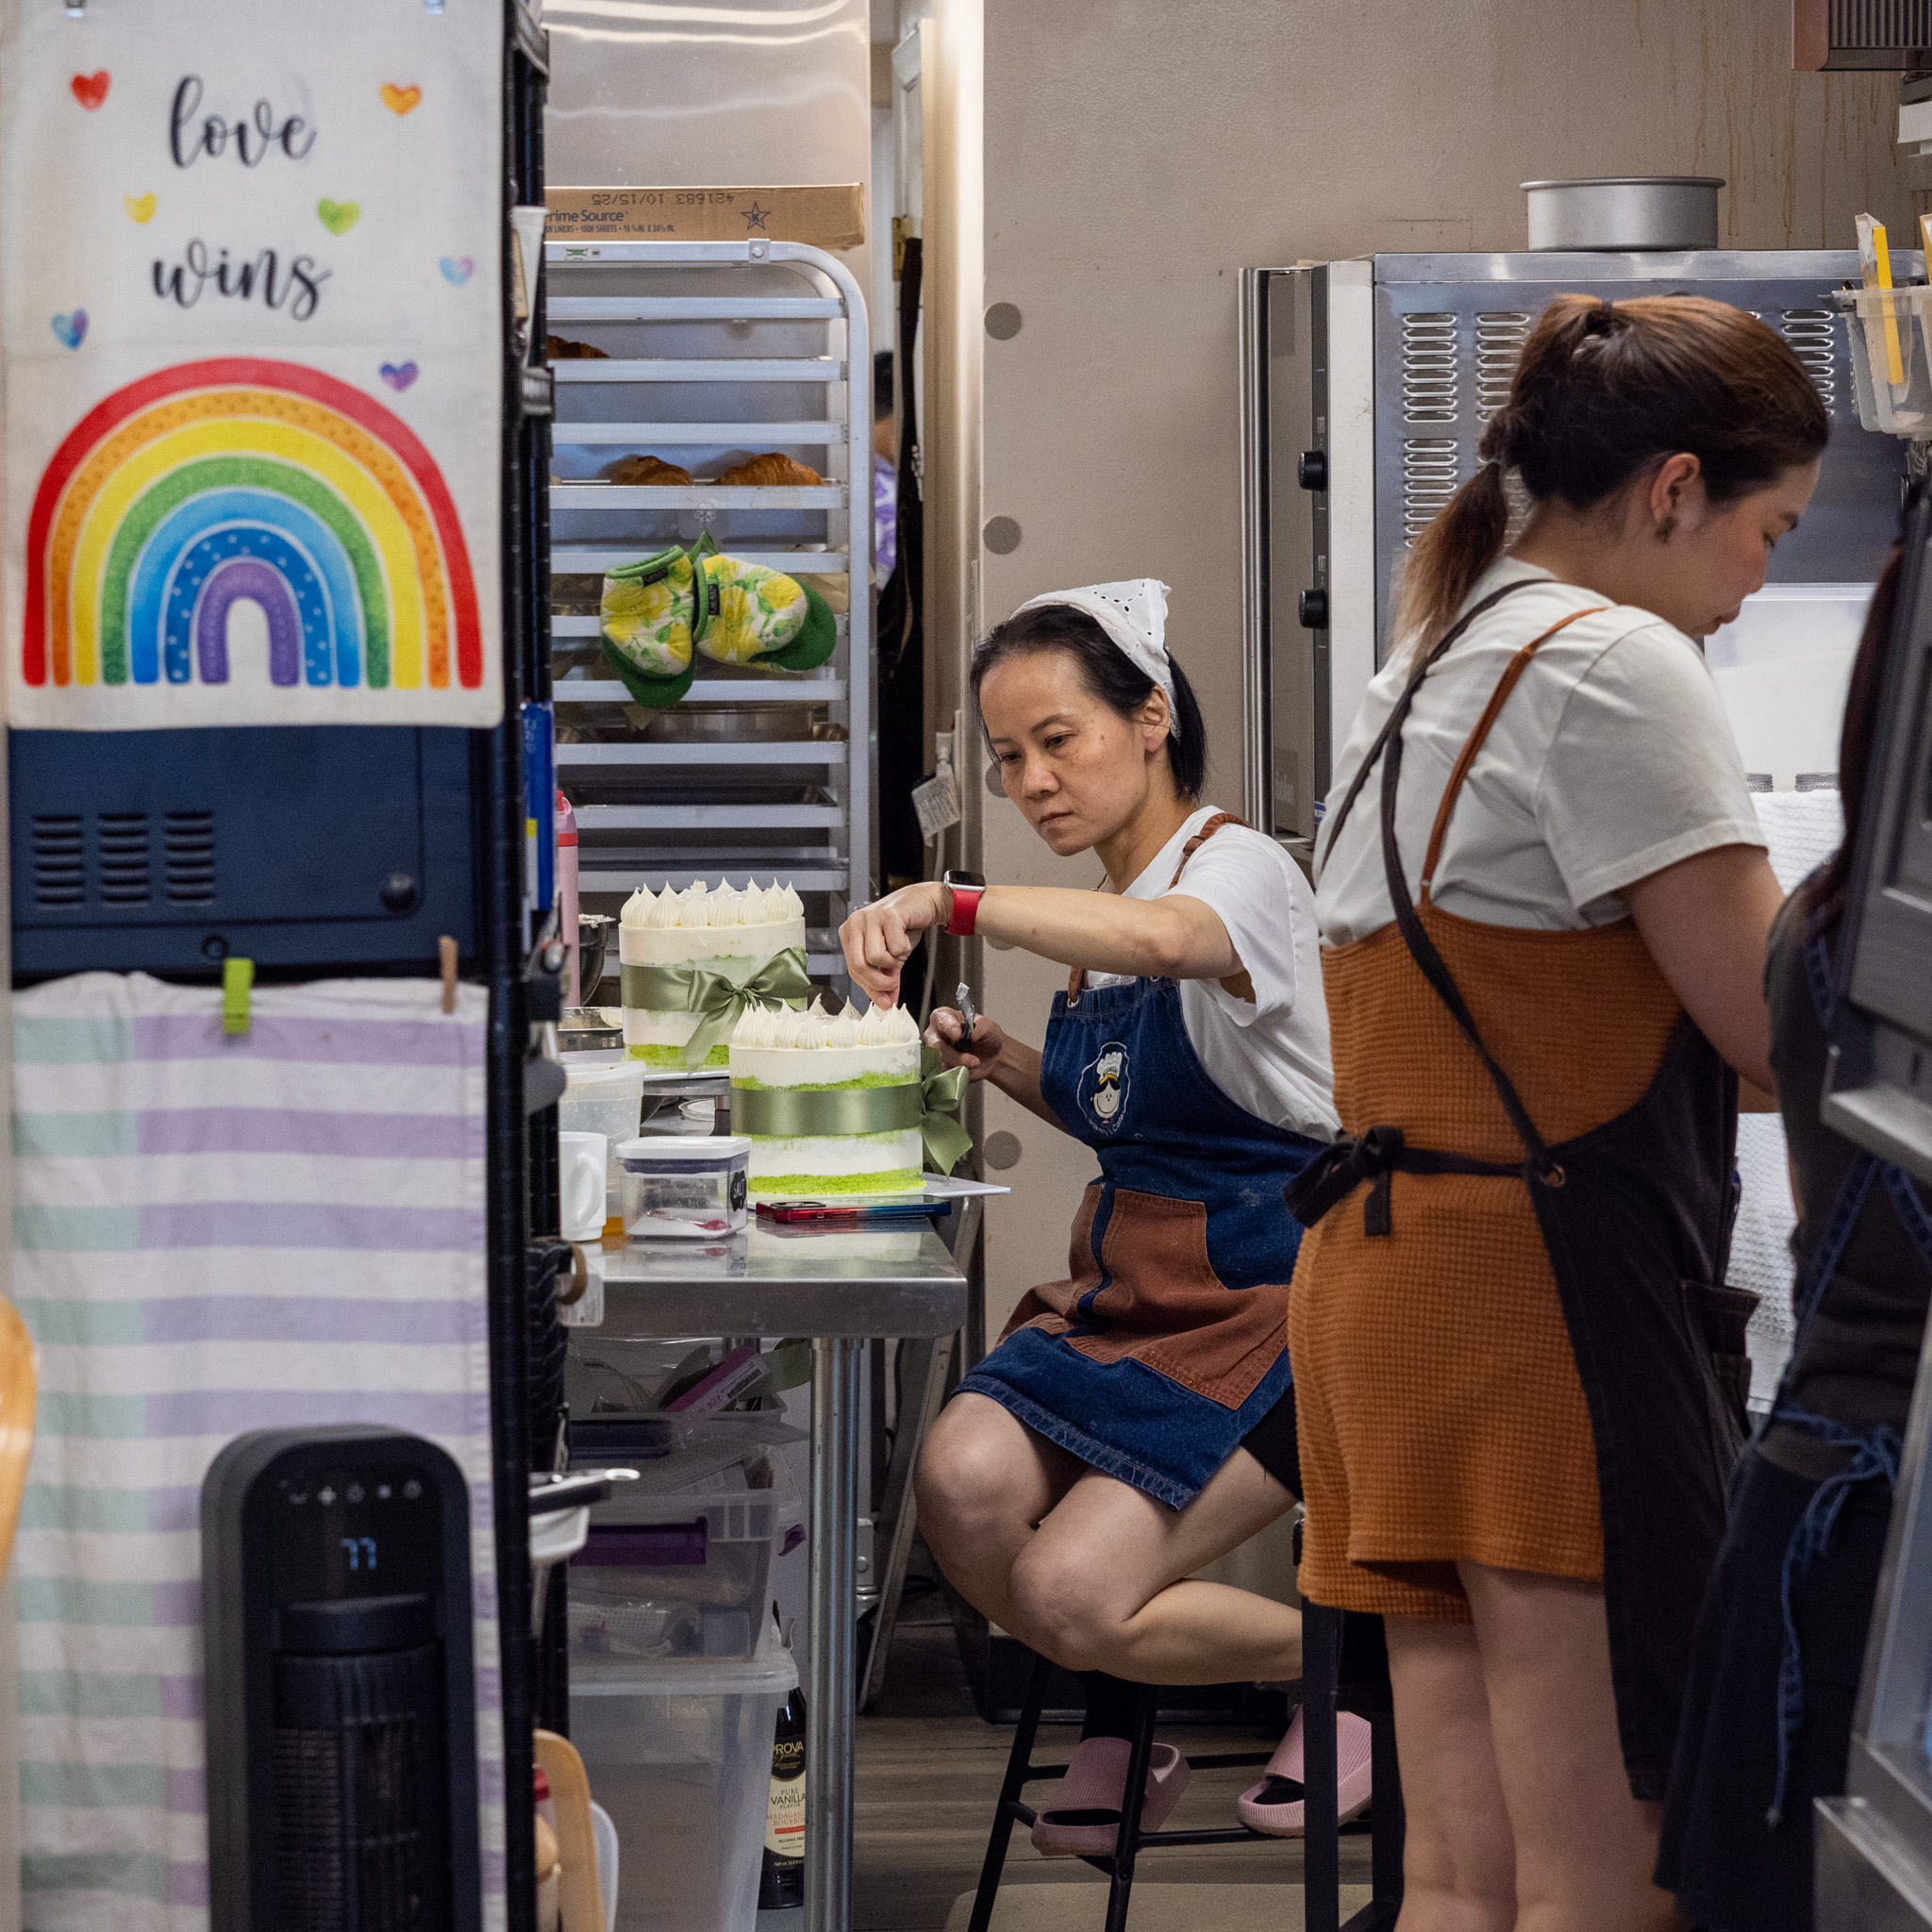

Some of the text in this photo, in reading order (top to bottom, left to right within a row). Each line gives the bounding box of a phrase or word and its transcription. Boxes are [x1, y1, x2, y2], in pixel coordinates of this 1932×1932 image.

[168, 74, 317, 170] love
[591, 192, 735, 206] 421683 10/15/25
[544, 209, 625, 223] rime Source
[543, 225, 553, 233] AN
[595, 225, 617, 233] SHEETS
[150, 237, 334, 323] wins
[341, 1538, 376, 1570] 77
[770, 1792, 806, 1805] VANILLA
[767, 1810, 805, 1822] MADAGASC
